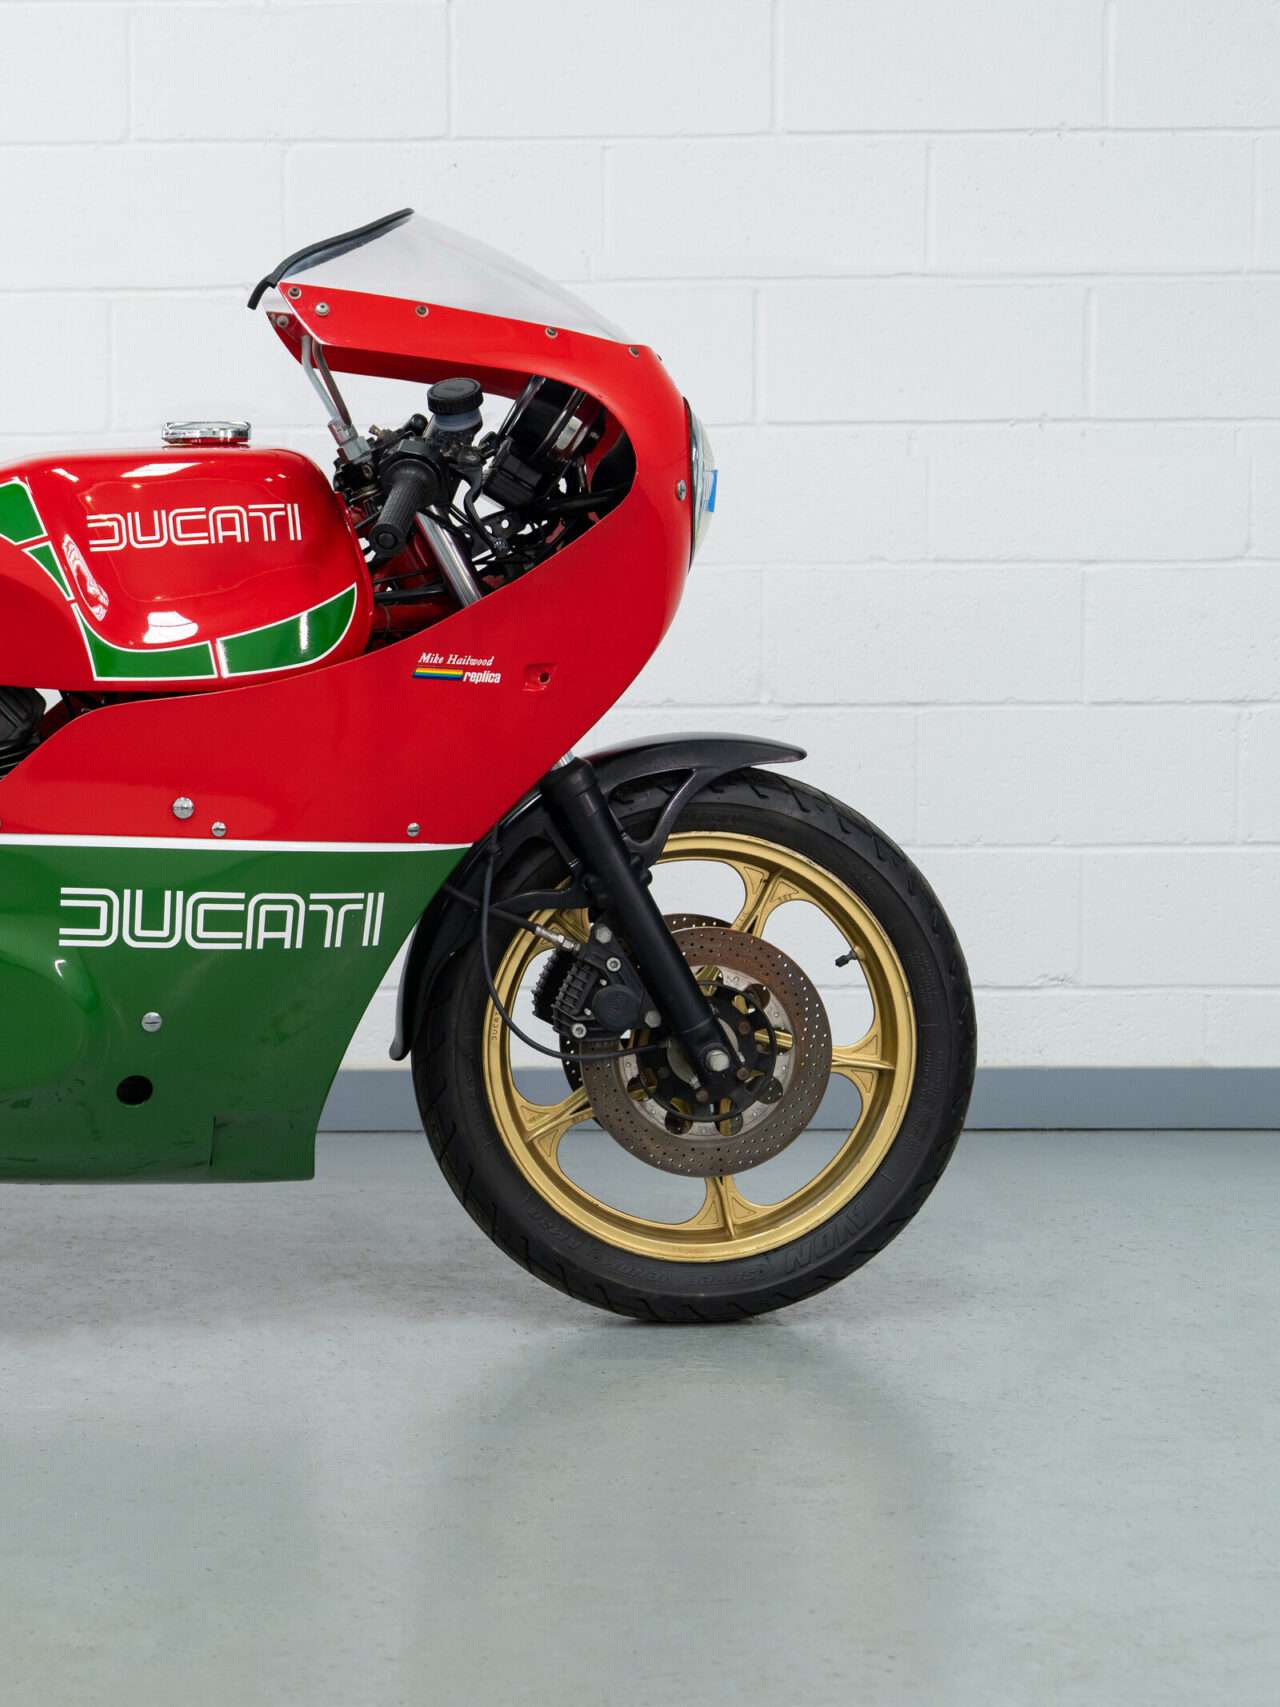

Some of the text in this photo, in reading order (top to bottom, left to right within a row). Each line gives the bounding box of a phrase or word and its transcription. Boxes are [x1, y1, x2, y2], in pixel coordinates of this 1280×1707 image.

[86, 503, 303, 552] DUCATI
[418, 652, 495, 667] Mike Hailwood
[463, 670, 502, 685] replica
[58, 887, 385, 950] DUCATI
